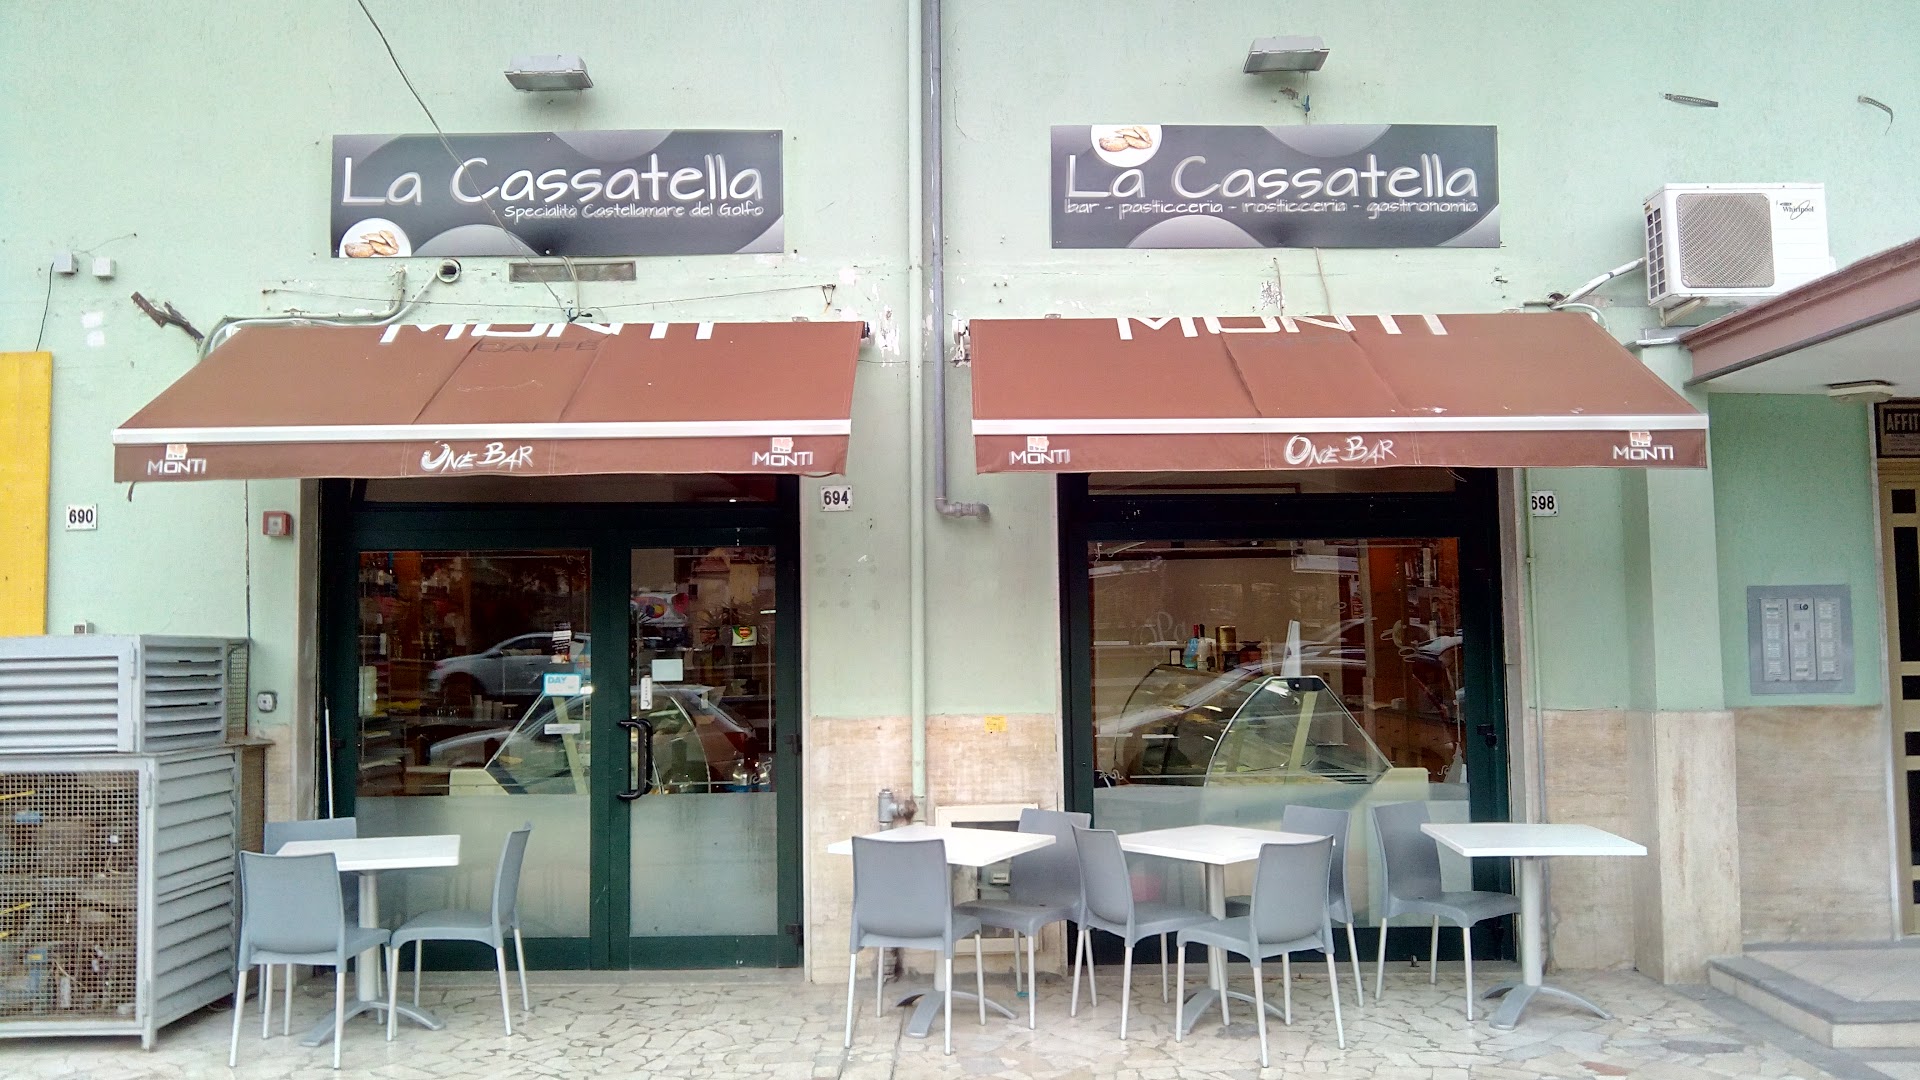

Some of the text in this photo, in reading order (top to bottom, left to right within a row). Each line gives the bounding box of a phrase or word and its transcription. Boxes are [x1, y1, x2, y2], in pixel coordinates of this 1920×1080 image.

[340, 153, 764, 206] La Cassatella
[1065, 153, 1478, 199] La Cassatella
[581, 203, 684, 219] Castellamare
[691, 201, 713, 217] del
[719, 200, 765, 217] Golfo
[1064, 199, 1100, 214] bar
[1118, 199, 1224, 220] pasticceria
[1241, 199, 1348, 214] rosticceria
[1367, 199, 1479, 219] gastronomia
[1783, 206, 1814, 214] Whirlpool
[752, 451, 814, 467] MONTI
[1008, 449, 1071, 466] MONTI
[1612, 444, 1675, 461] MONTI
[147, 458, 207, 476] MONTI
[823, 490, 850, 506] 694
[1531, 495, 1555, 510] 698
[69, 508, 94, 524] 690
[547, 675, 567, 684] DAY
